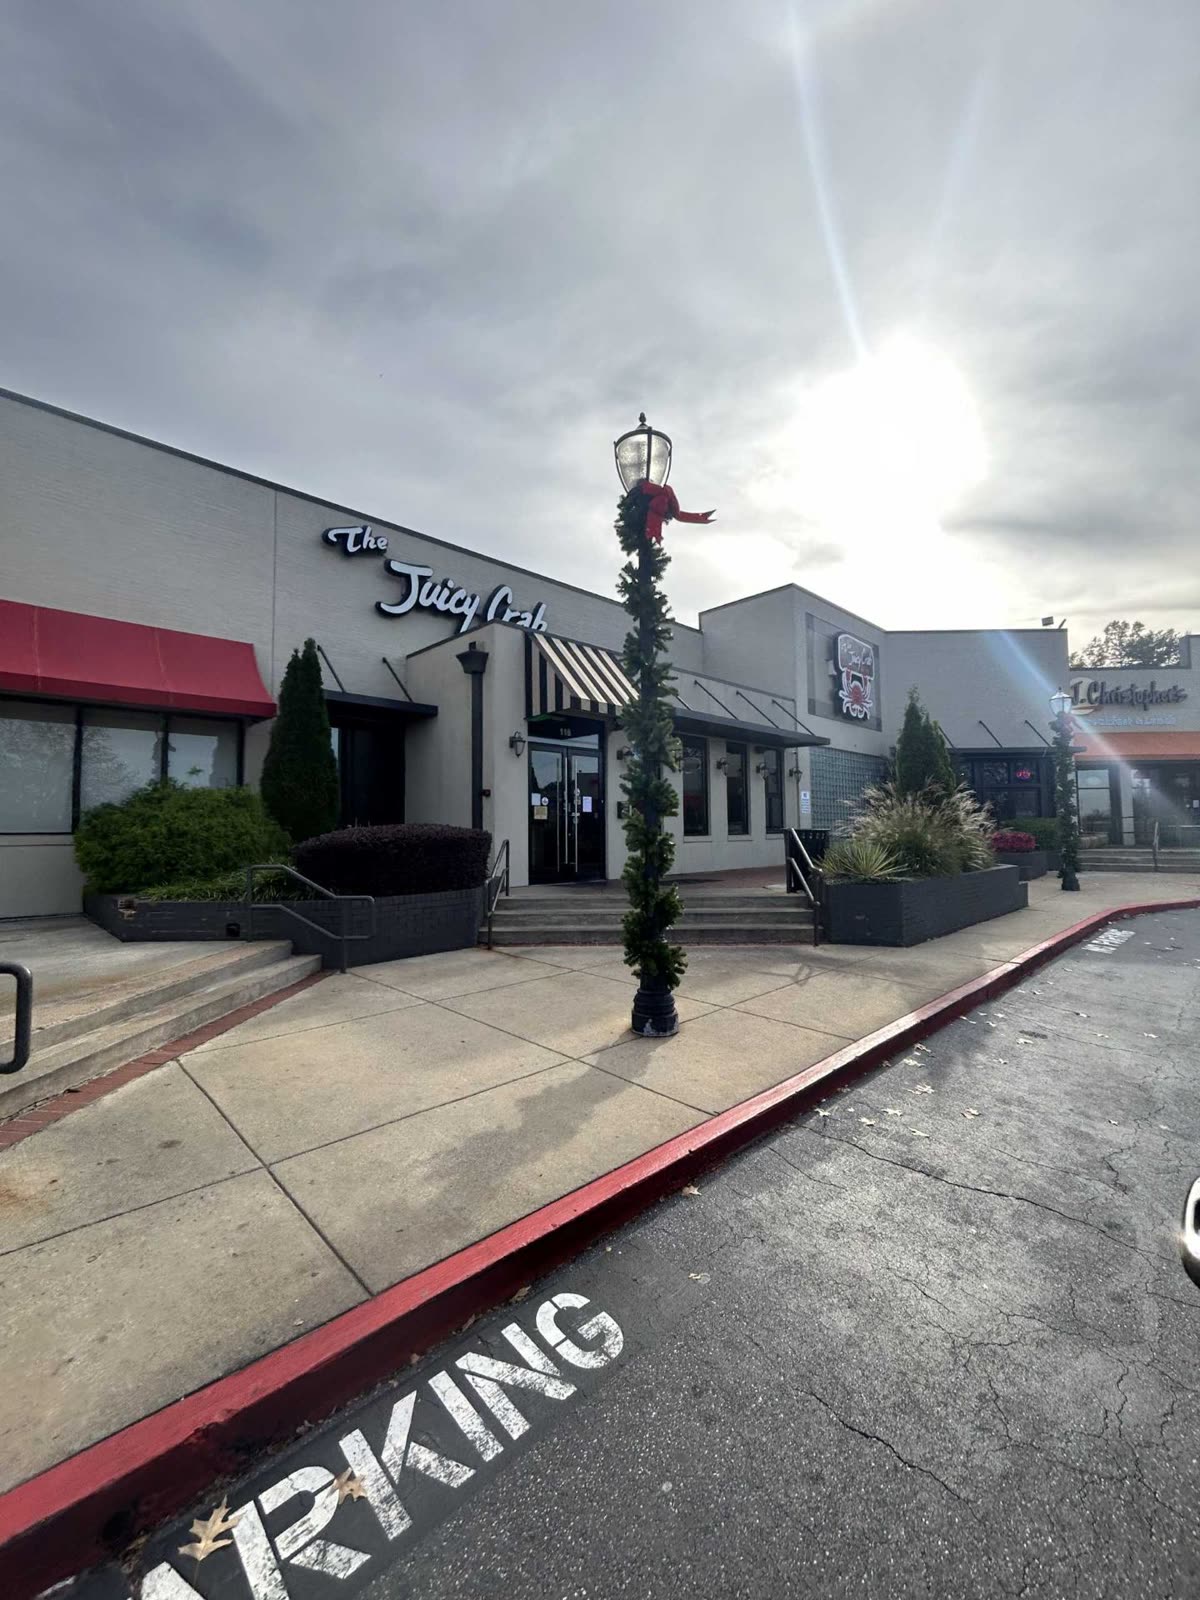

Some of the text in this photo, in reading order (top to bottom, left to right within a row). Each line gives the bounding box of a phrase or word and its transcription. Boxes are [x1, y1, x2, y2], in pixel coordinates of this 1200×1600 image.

[325, 526, 388, 553] The
[378, 559, 480, 634] Juicy
[136, 1293, 624, 1600] RKING
